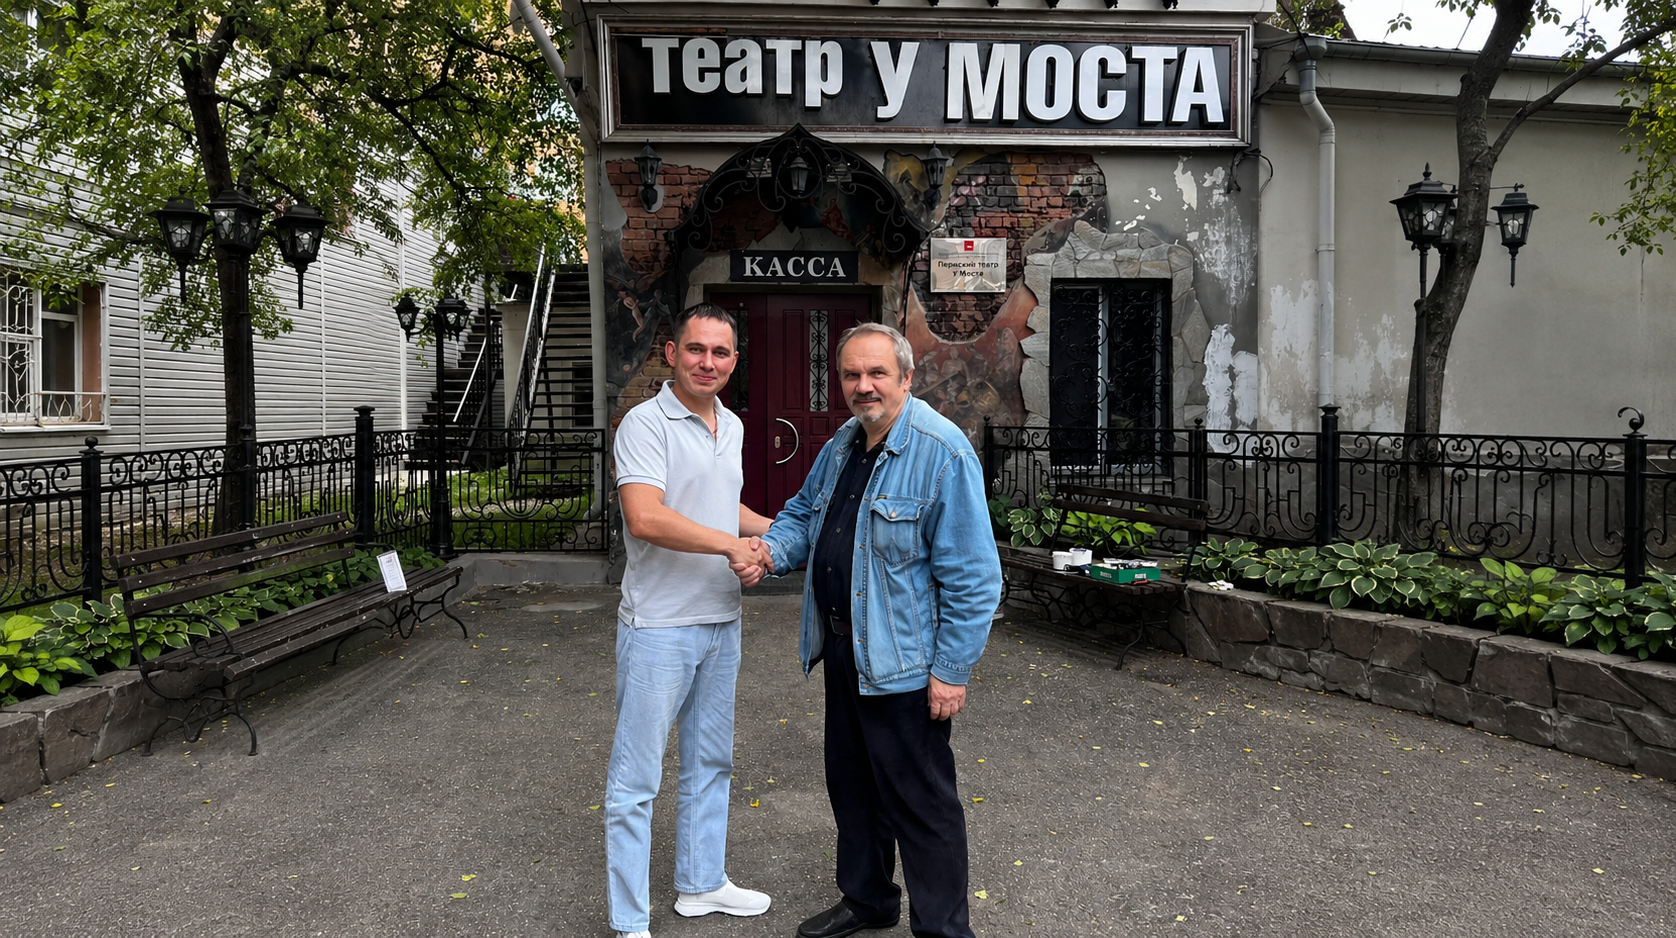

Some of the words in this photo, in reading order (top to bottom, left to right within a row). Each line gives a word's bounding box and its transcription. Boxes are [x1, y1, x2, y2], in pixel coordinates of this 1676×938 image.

[946, 42, 1226, 124] МОСТА
[743, 256, 847, 277] КАССА
[978, 261, 999, 269] театр
